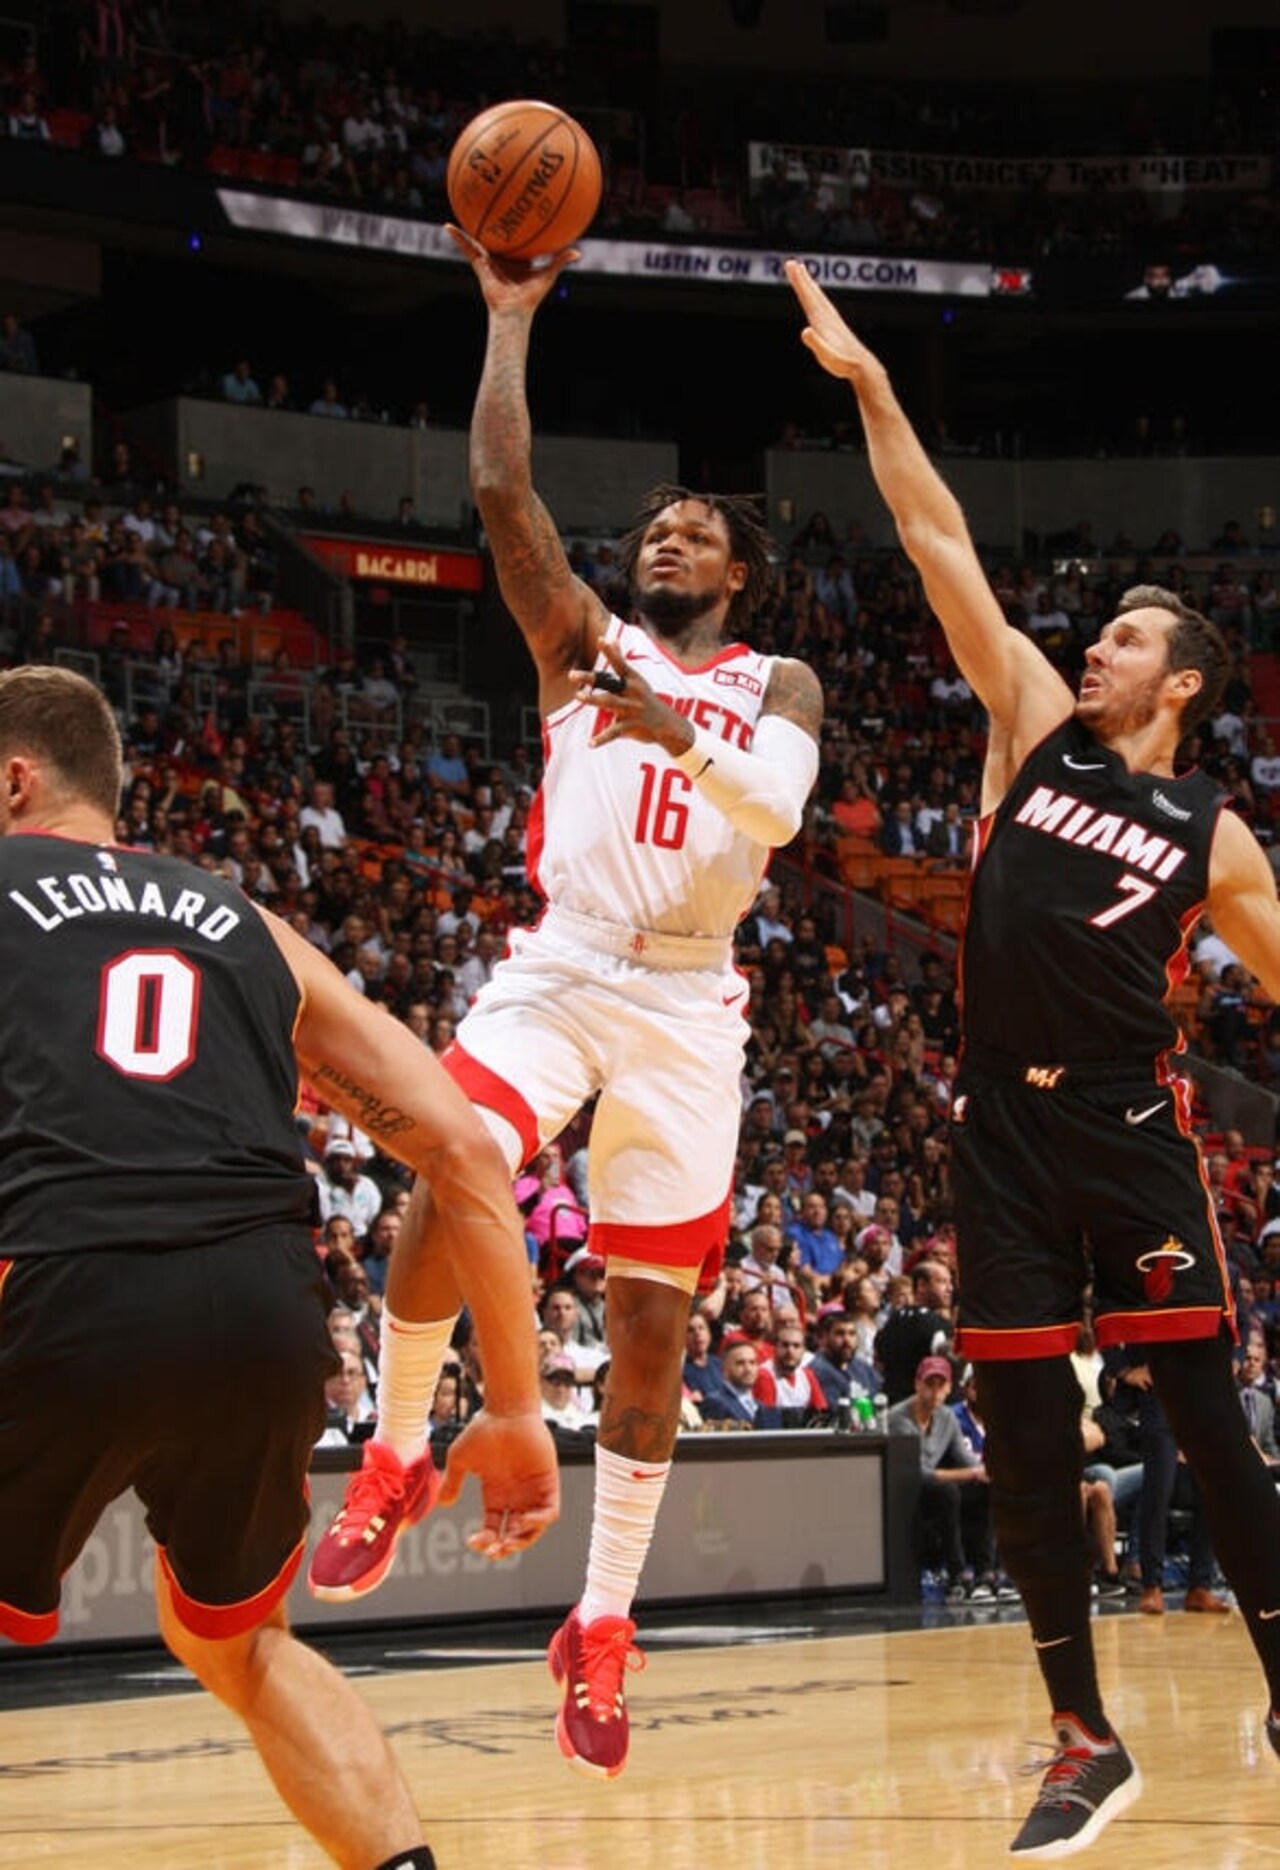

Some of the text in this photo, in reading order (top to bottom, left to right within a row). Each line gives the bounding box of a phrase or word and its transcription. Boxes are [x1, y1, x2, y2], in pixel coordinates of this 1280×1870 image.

[491, 144, 565, 242] SPALDING
[644, 251, 918, 285] LISTEN ON RDIO.COM
[357, 553, 438, 584] BACARDÍ
[634, 761, 693, 851] 16
[1013, 785, 1188, 883] MIAMI
[8, 872, 242, 943] LEONARD
[1086, 872, 1158, 930] 7
[96, 946, 203, 1082] 0
